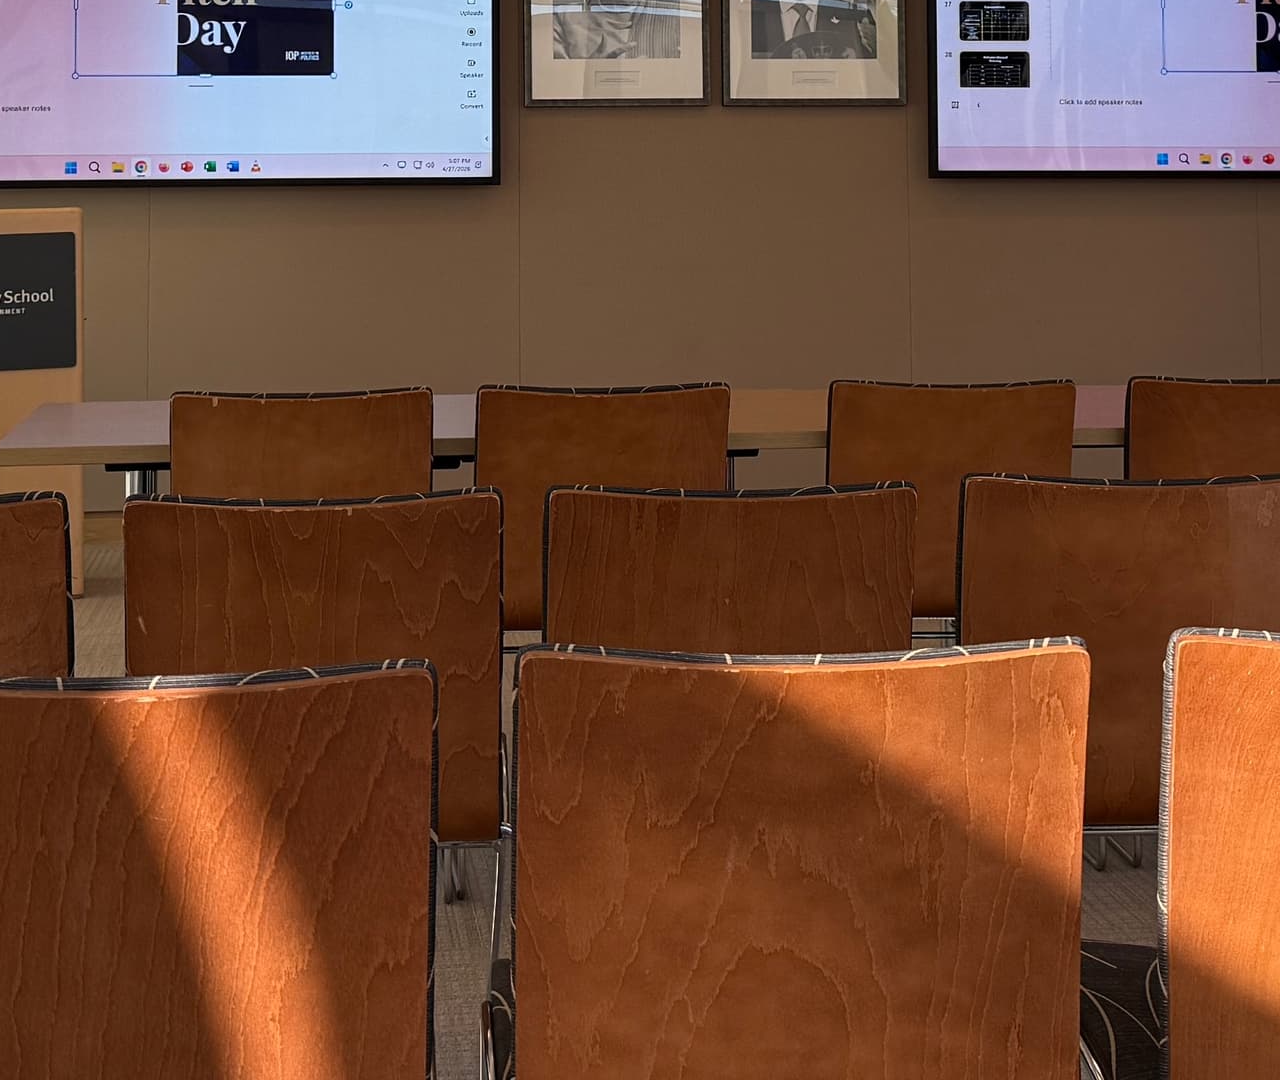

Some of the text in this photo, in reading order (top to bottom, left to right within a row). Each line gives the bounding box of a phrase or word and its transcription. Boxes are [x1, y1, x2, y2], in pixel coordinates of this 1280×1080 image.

[177, 12, 247, 54] Day
[285, 50, 300, 61] IOP
[1098, 99, 1124, 107] speaker
[1, 105, 30, 113] speaker
[3, 287, 55, 304] School
